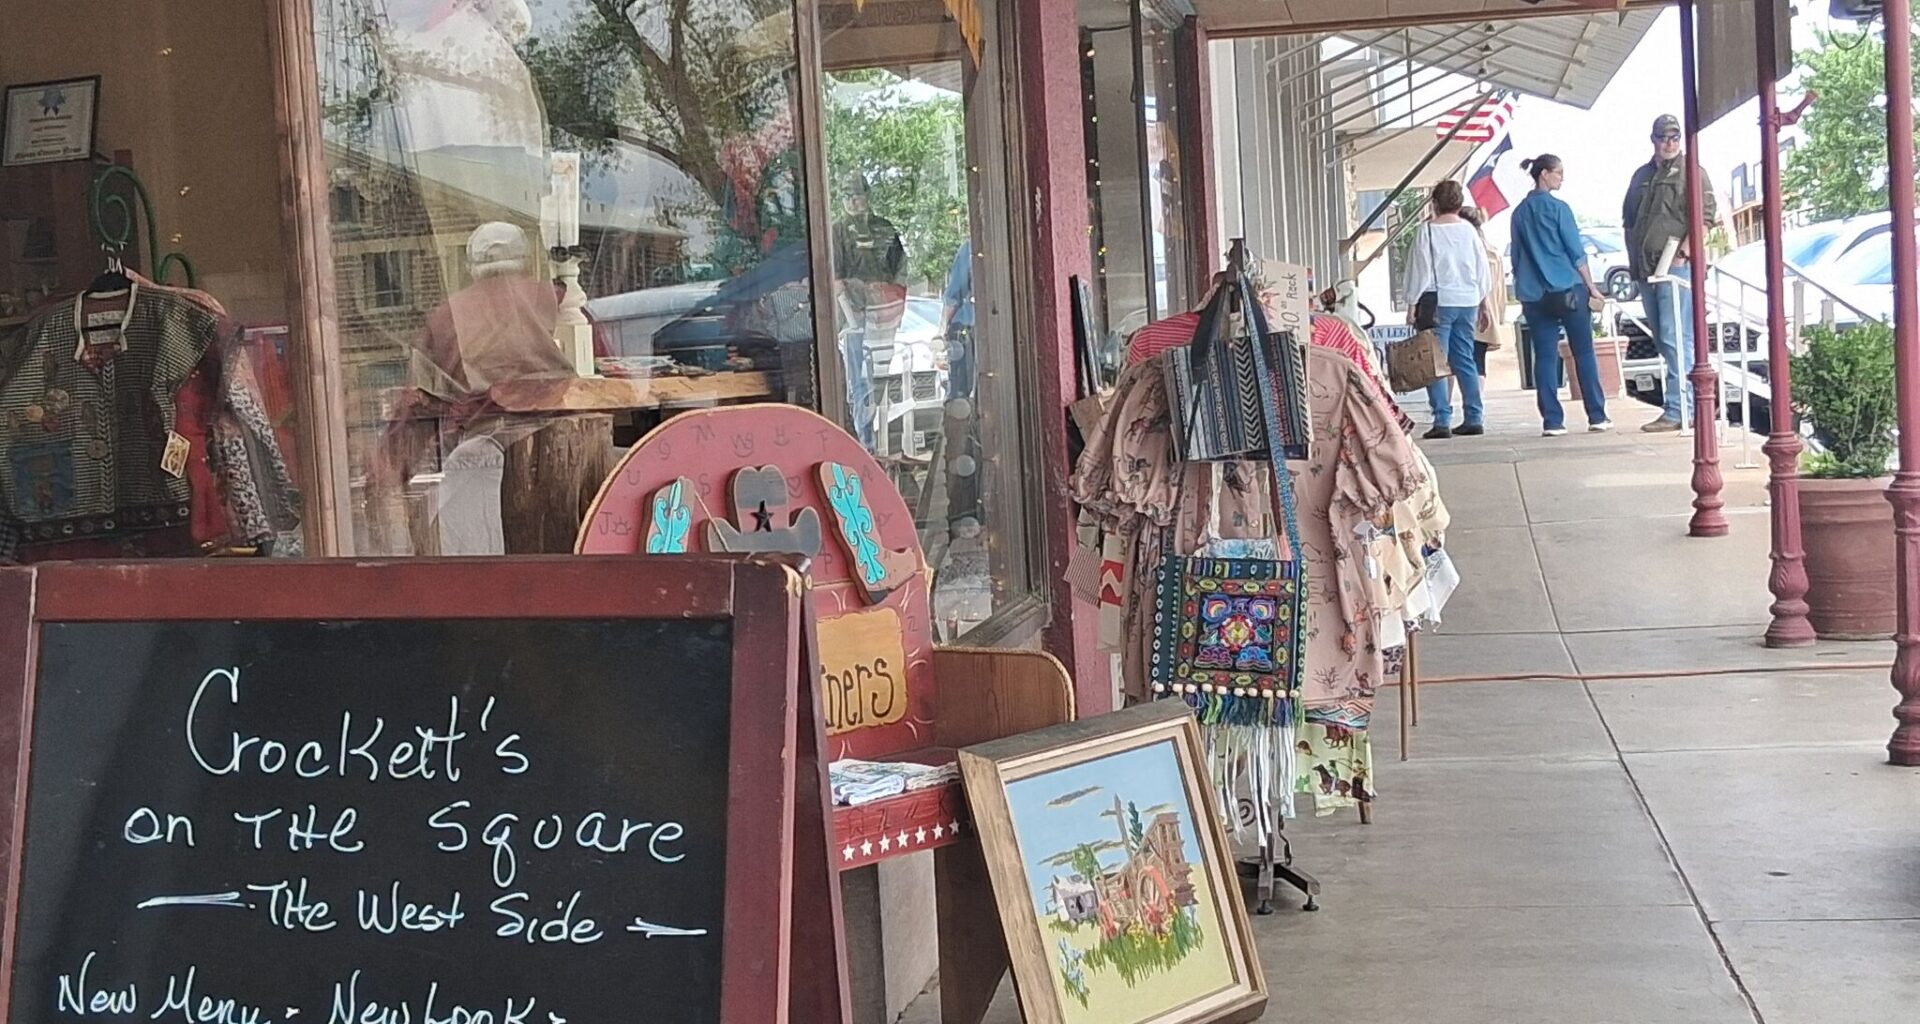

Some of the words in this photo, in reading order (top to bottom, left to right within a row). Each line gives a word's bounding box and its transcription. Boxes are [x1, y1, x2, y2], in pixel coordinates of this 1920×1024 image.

[1370, 327, 1384, 339] AN
[820, 657, 896, 730] ners
[427, 801, 687, 888] Square
[357, 881, 465, 934] West
[489, 891, 604, 945] Side
[58, 951, 137, 1015] New
[150, 965, 271, 1024] Menu
[328, 969, 411, 1024] New
